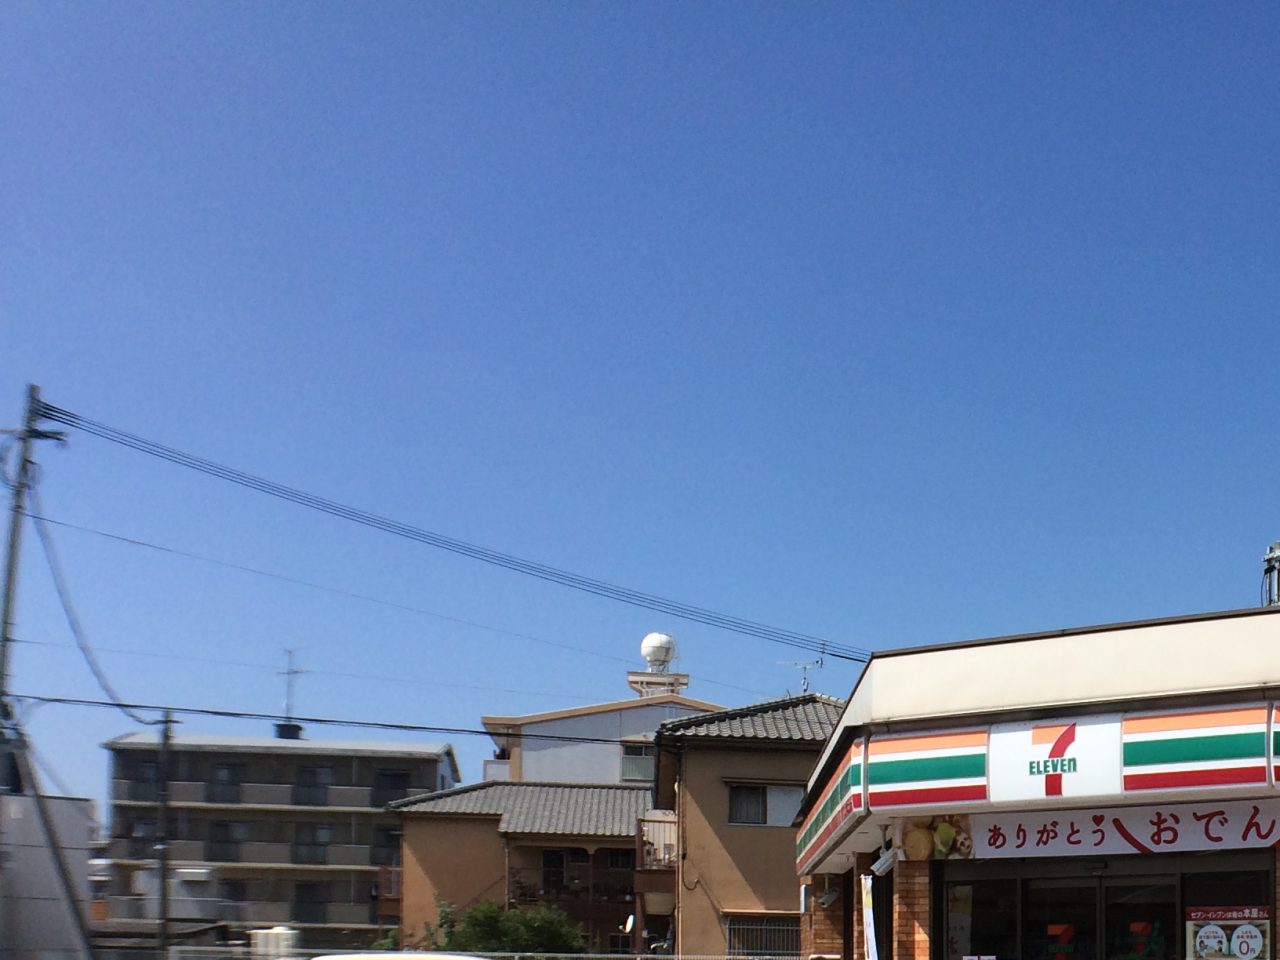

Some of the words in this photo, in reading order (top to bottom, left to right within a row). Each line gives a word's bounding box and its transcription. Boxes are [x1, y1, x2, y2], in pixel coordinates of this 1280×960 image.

[1031, 722, 1077, 797] 7
[987, 813, 1106, 849] ありがとう
[1150, 805, 1276, 847] おでん
